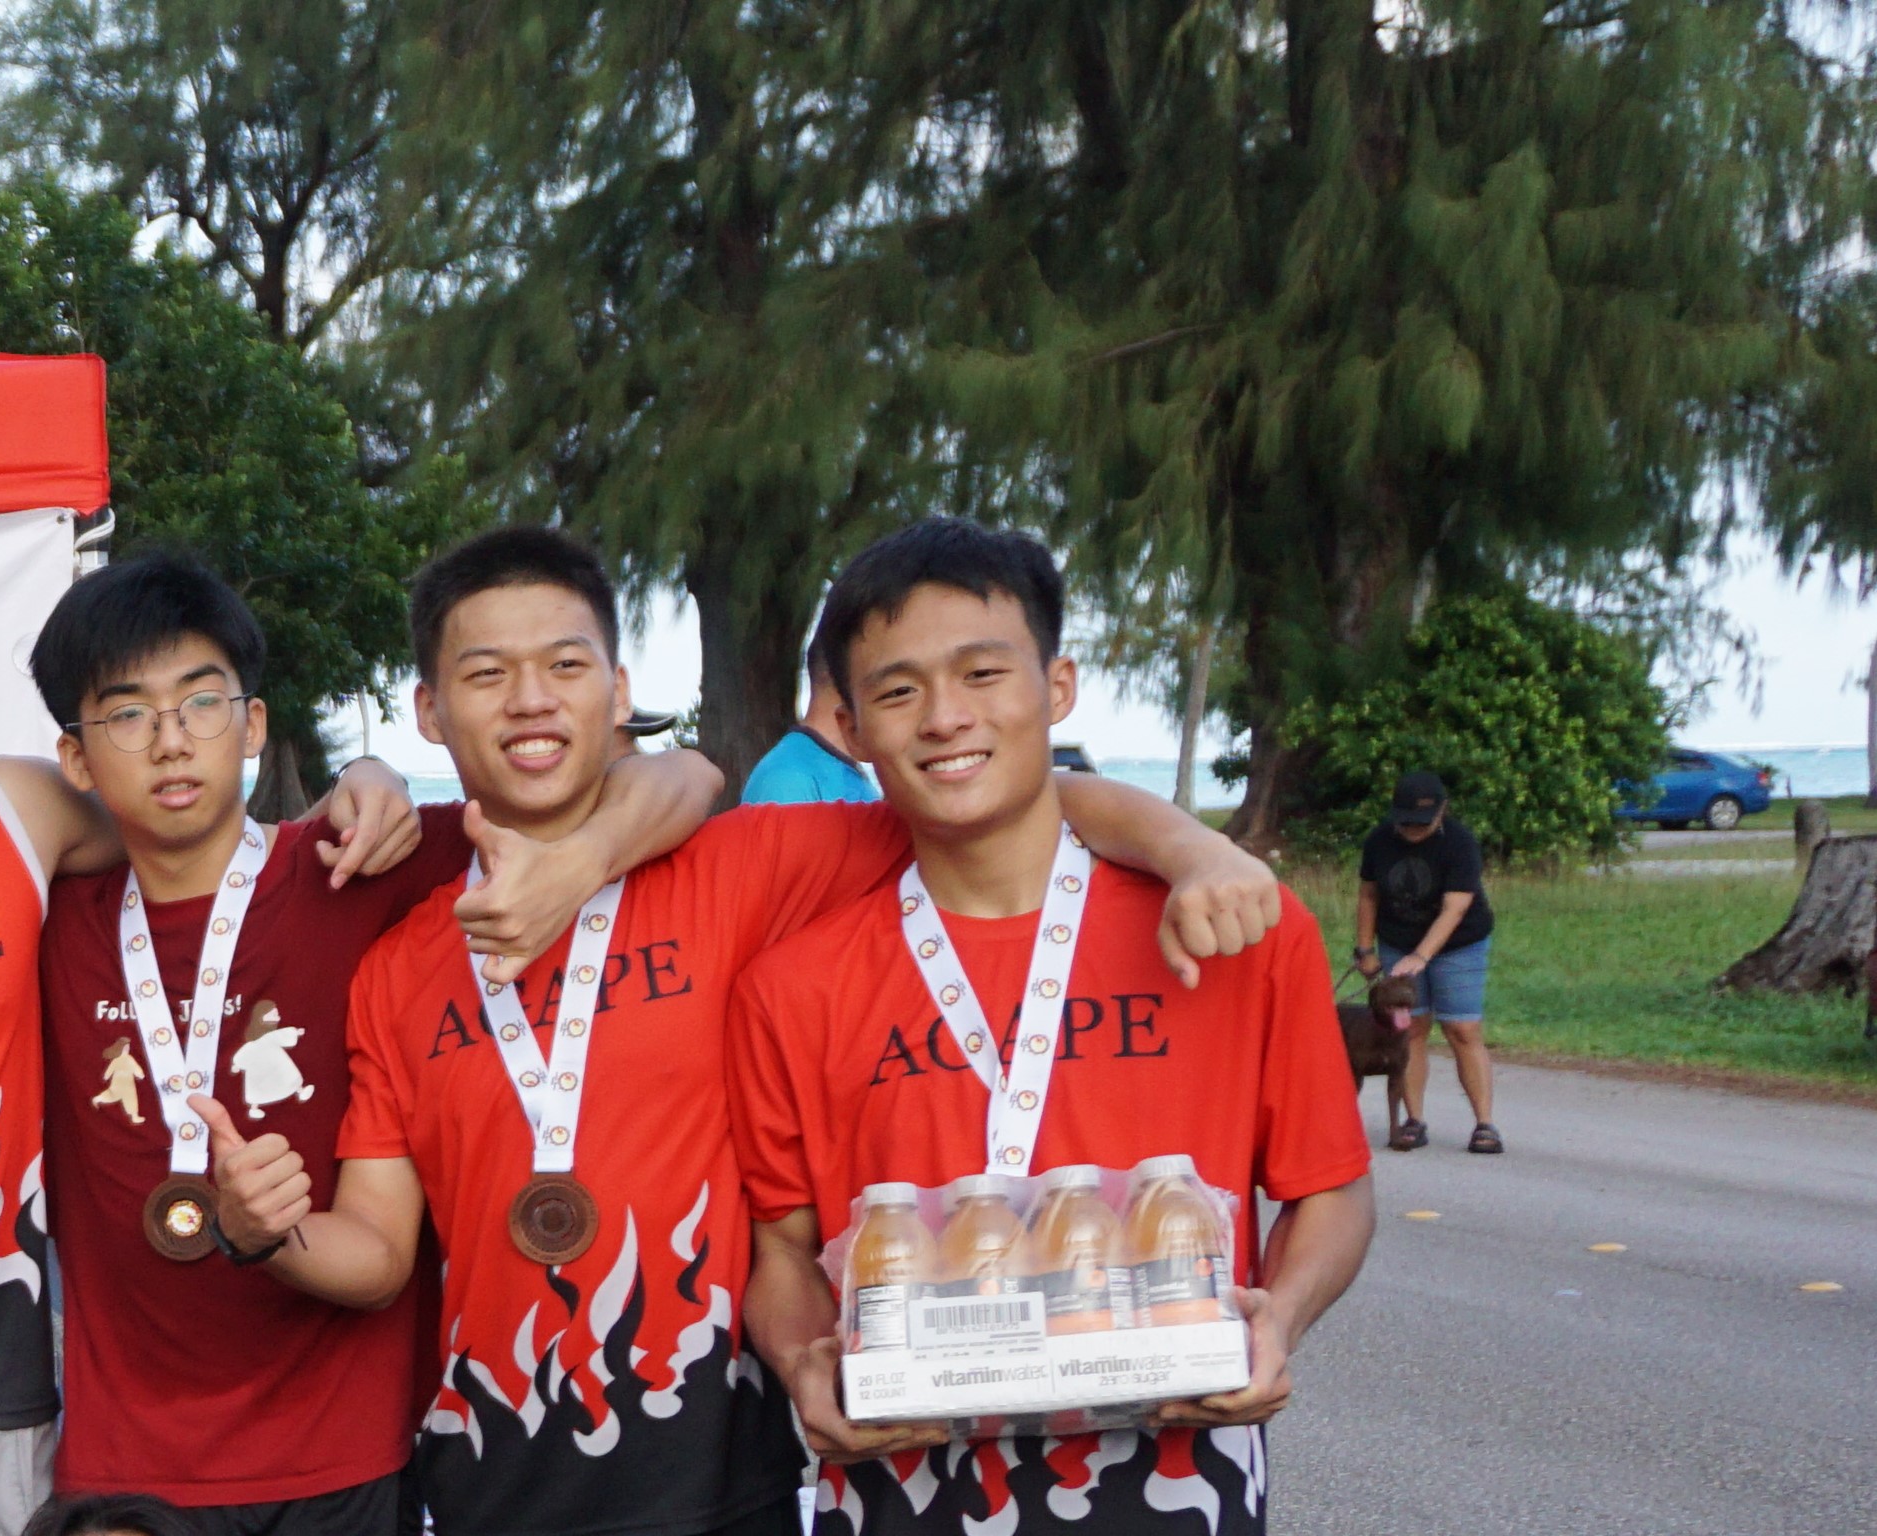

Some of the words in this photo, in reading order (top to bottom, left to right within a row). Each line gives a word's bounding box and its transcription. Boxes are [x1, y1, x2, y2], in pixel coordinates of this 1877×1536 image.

[97, 1000, 138, 1021] Foll
[858, 1375, 872, 1387] 20
[859, 1390, 870, 1400] 12
[873, 1387, 906, 1399] COUNT
